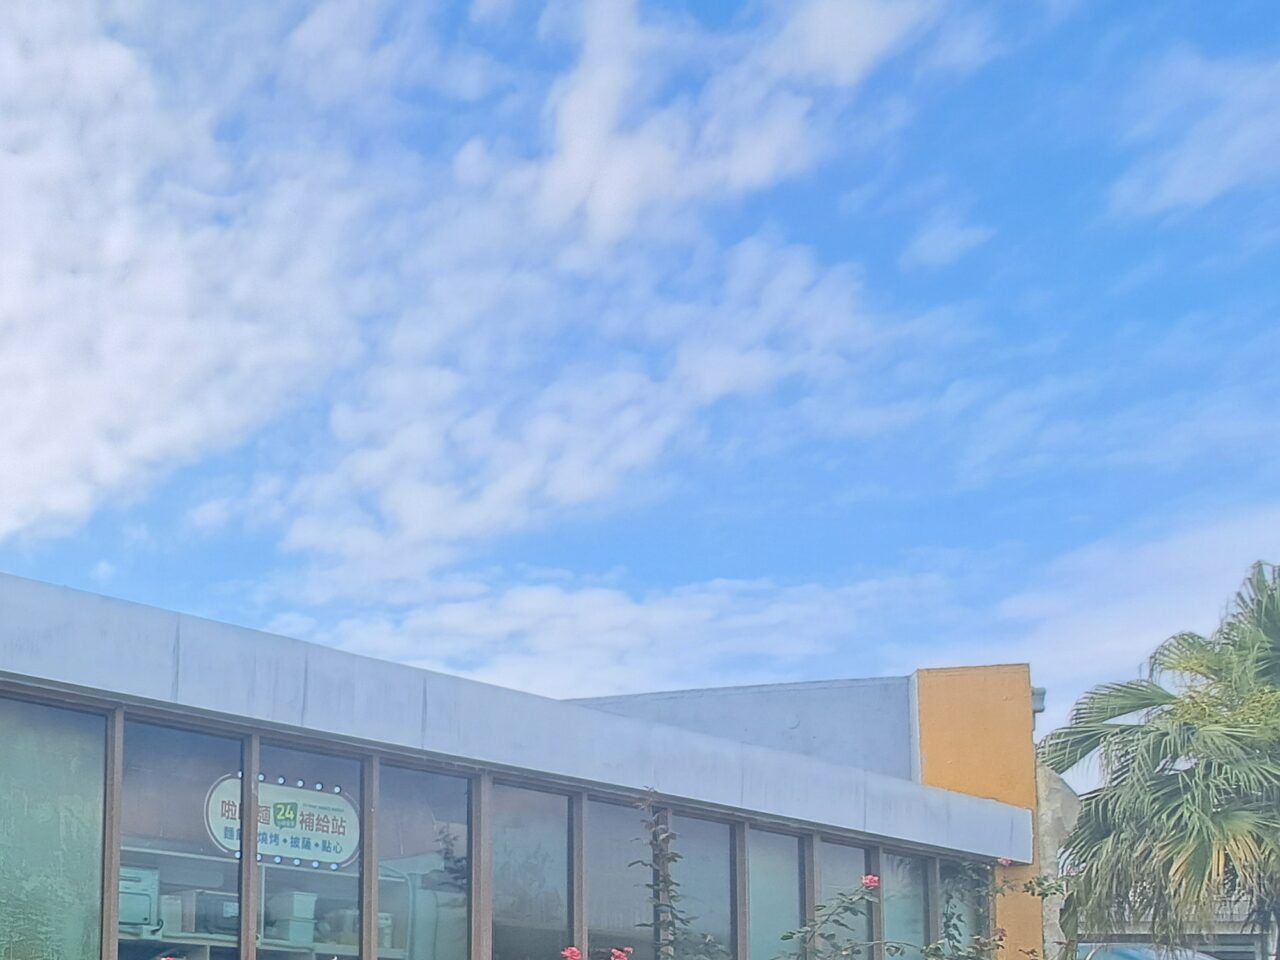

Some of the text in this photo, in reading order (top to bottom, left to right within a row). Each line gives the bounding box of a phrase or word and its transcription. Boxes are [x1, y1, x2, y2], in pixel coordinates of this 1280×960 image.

[221, 799, 347, 836] 啦麵 24 補給站
[290, 835, 312, 851] 披薩
[321, 839, 343, 854] 點心
